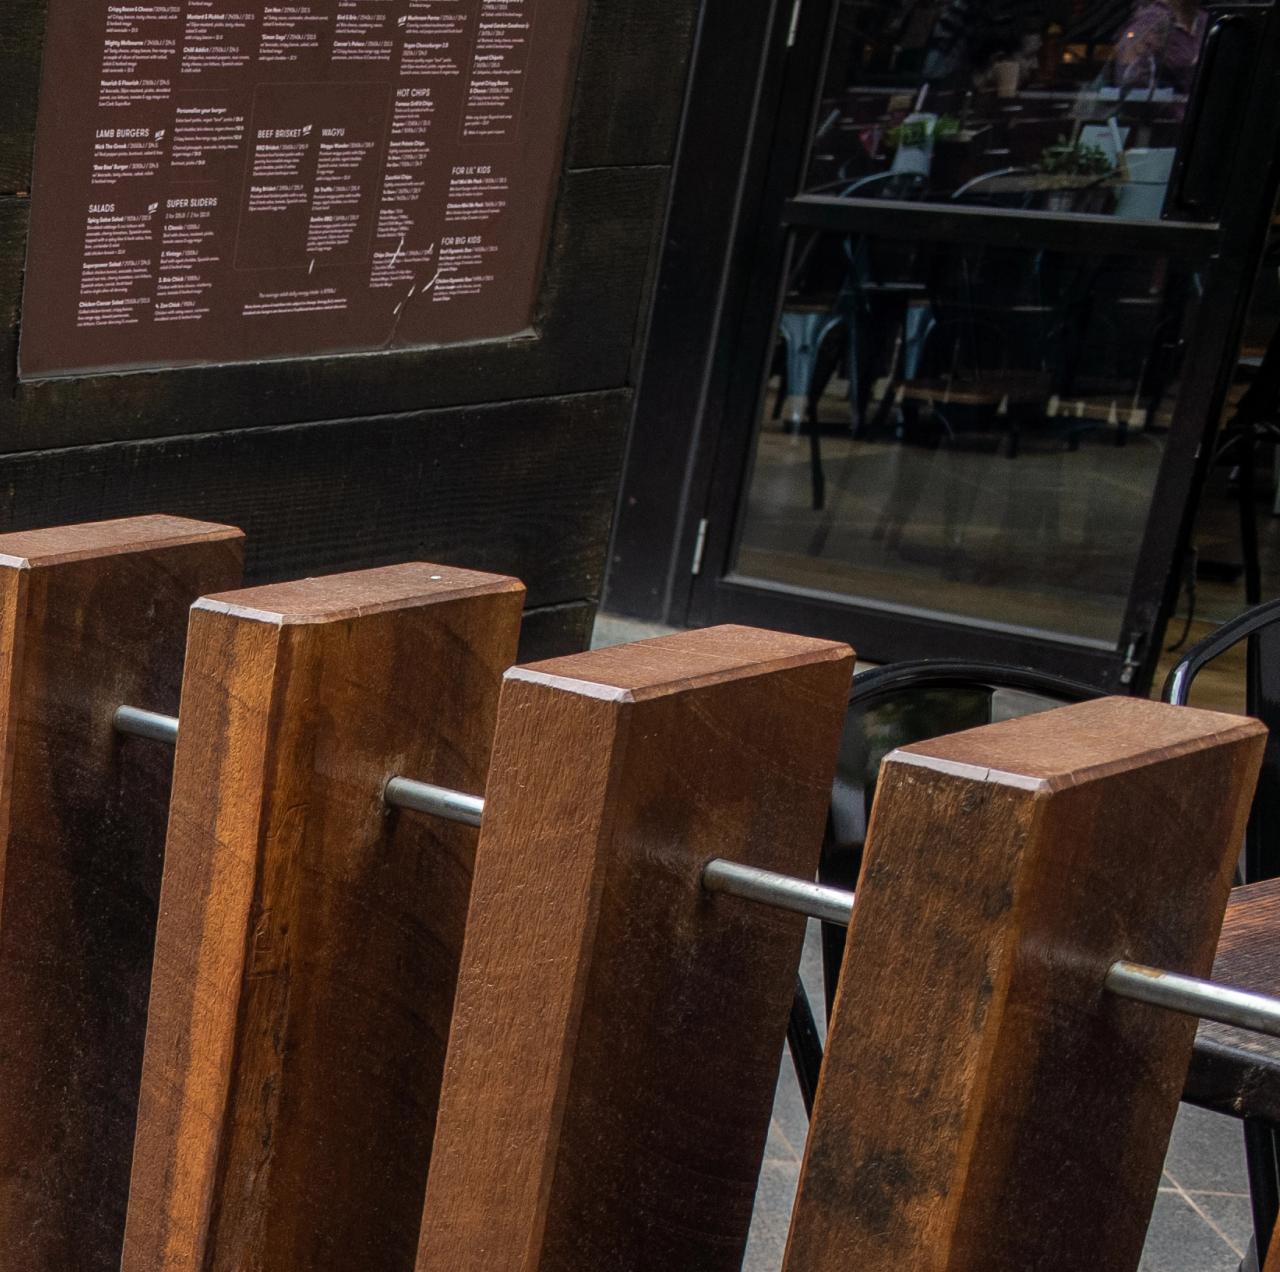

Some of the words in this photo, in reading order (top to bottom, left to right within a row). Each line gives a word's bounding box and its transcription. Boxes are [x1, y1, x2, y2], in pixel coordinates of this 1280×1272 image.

[396, 88, 409, 97] HOT
[410, 88, 430, 97] CHIPS
[96, 128, 115, 138] LAMB
[116, 128, 150, 138] BURGERS
[257, 129, 273, 138] BEEF
[275, 129, 301, 138] BRISKET
[321, 128, 346, 137] WAGYU
[452, 166, 465, 175] FOR
[477, 166, 492, 175] KIDS
[166, 198, 189, 208] SUPER
[190, 198, 218, 208] SLIDERS
[88, 203, 116, 213] SALADS
[441, 236, 454, 245] FOR
[455, 236, 466, 245] BIG
[467, 236, 481, 245] KIDS
